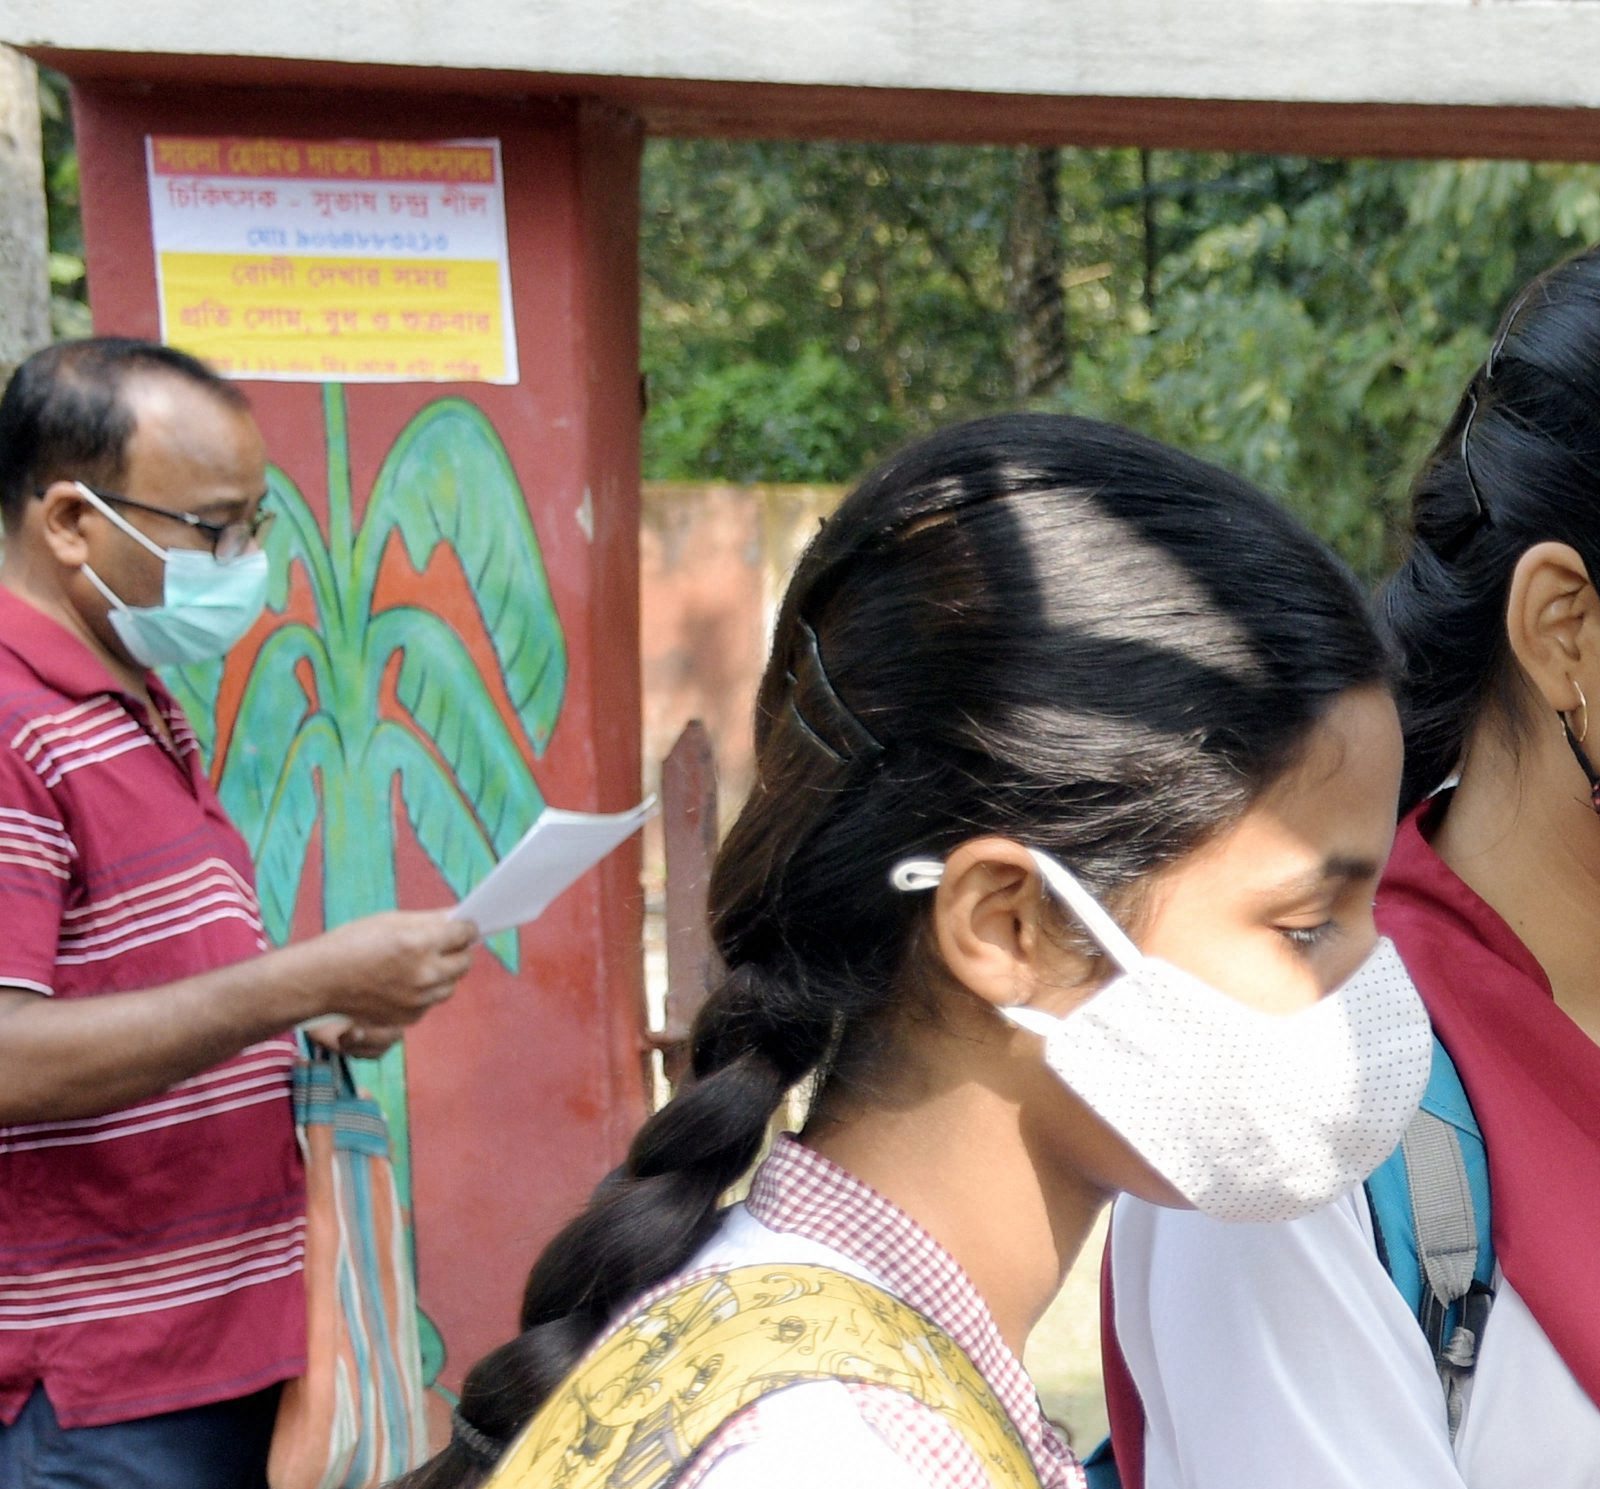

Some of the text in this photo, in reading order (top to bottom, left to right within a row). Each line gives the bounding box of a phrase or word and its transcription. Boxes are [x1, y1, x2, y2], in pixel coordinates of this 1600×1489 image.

[167, 178, 279, 208] চিকিৎসক
[310, 189, 377, 218] সুভাষ
[387, 191, 430, 218] চন্দ্র
[440, 183, 488, 216] শীল
[231, 255, 450, 289] রোগী দেখার সময়
[179, 297, 232, 329] প্রতি
[322, 309, 358, 337] বুধ
